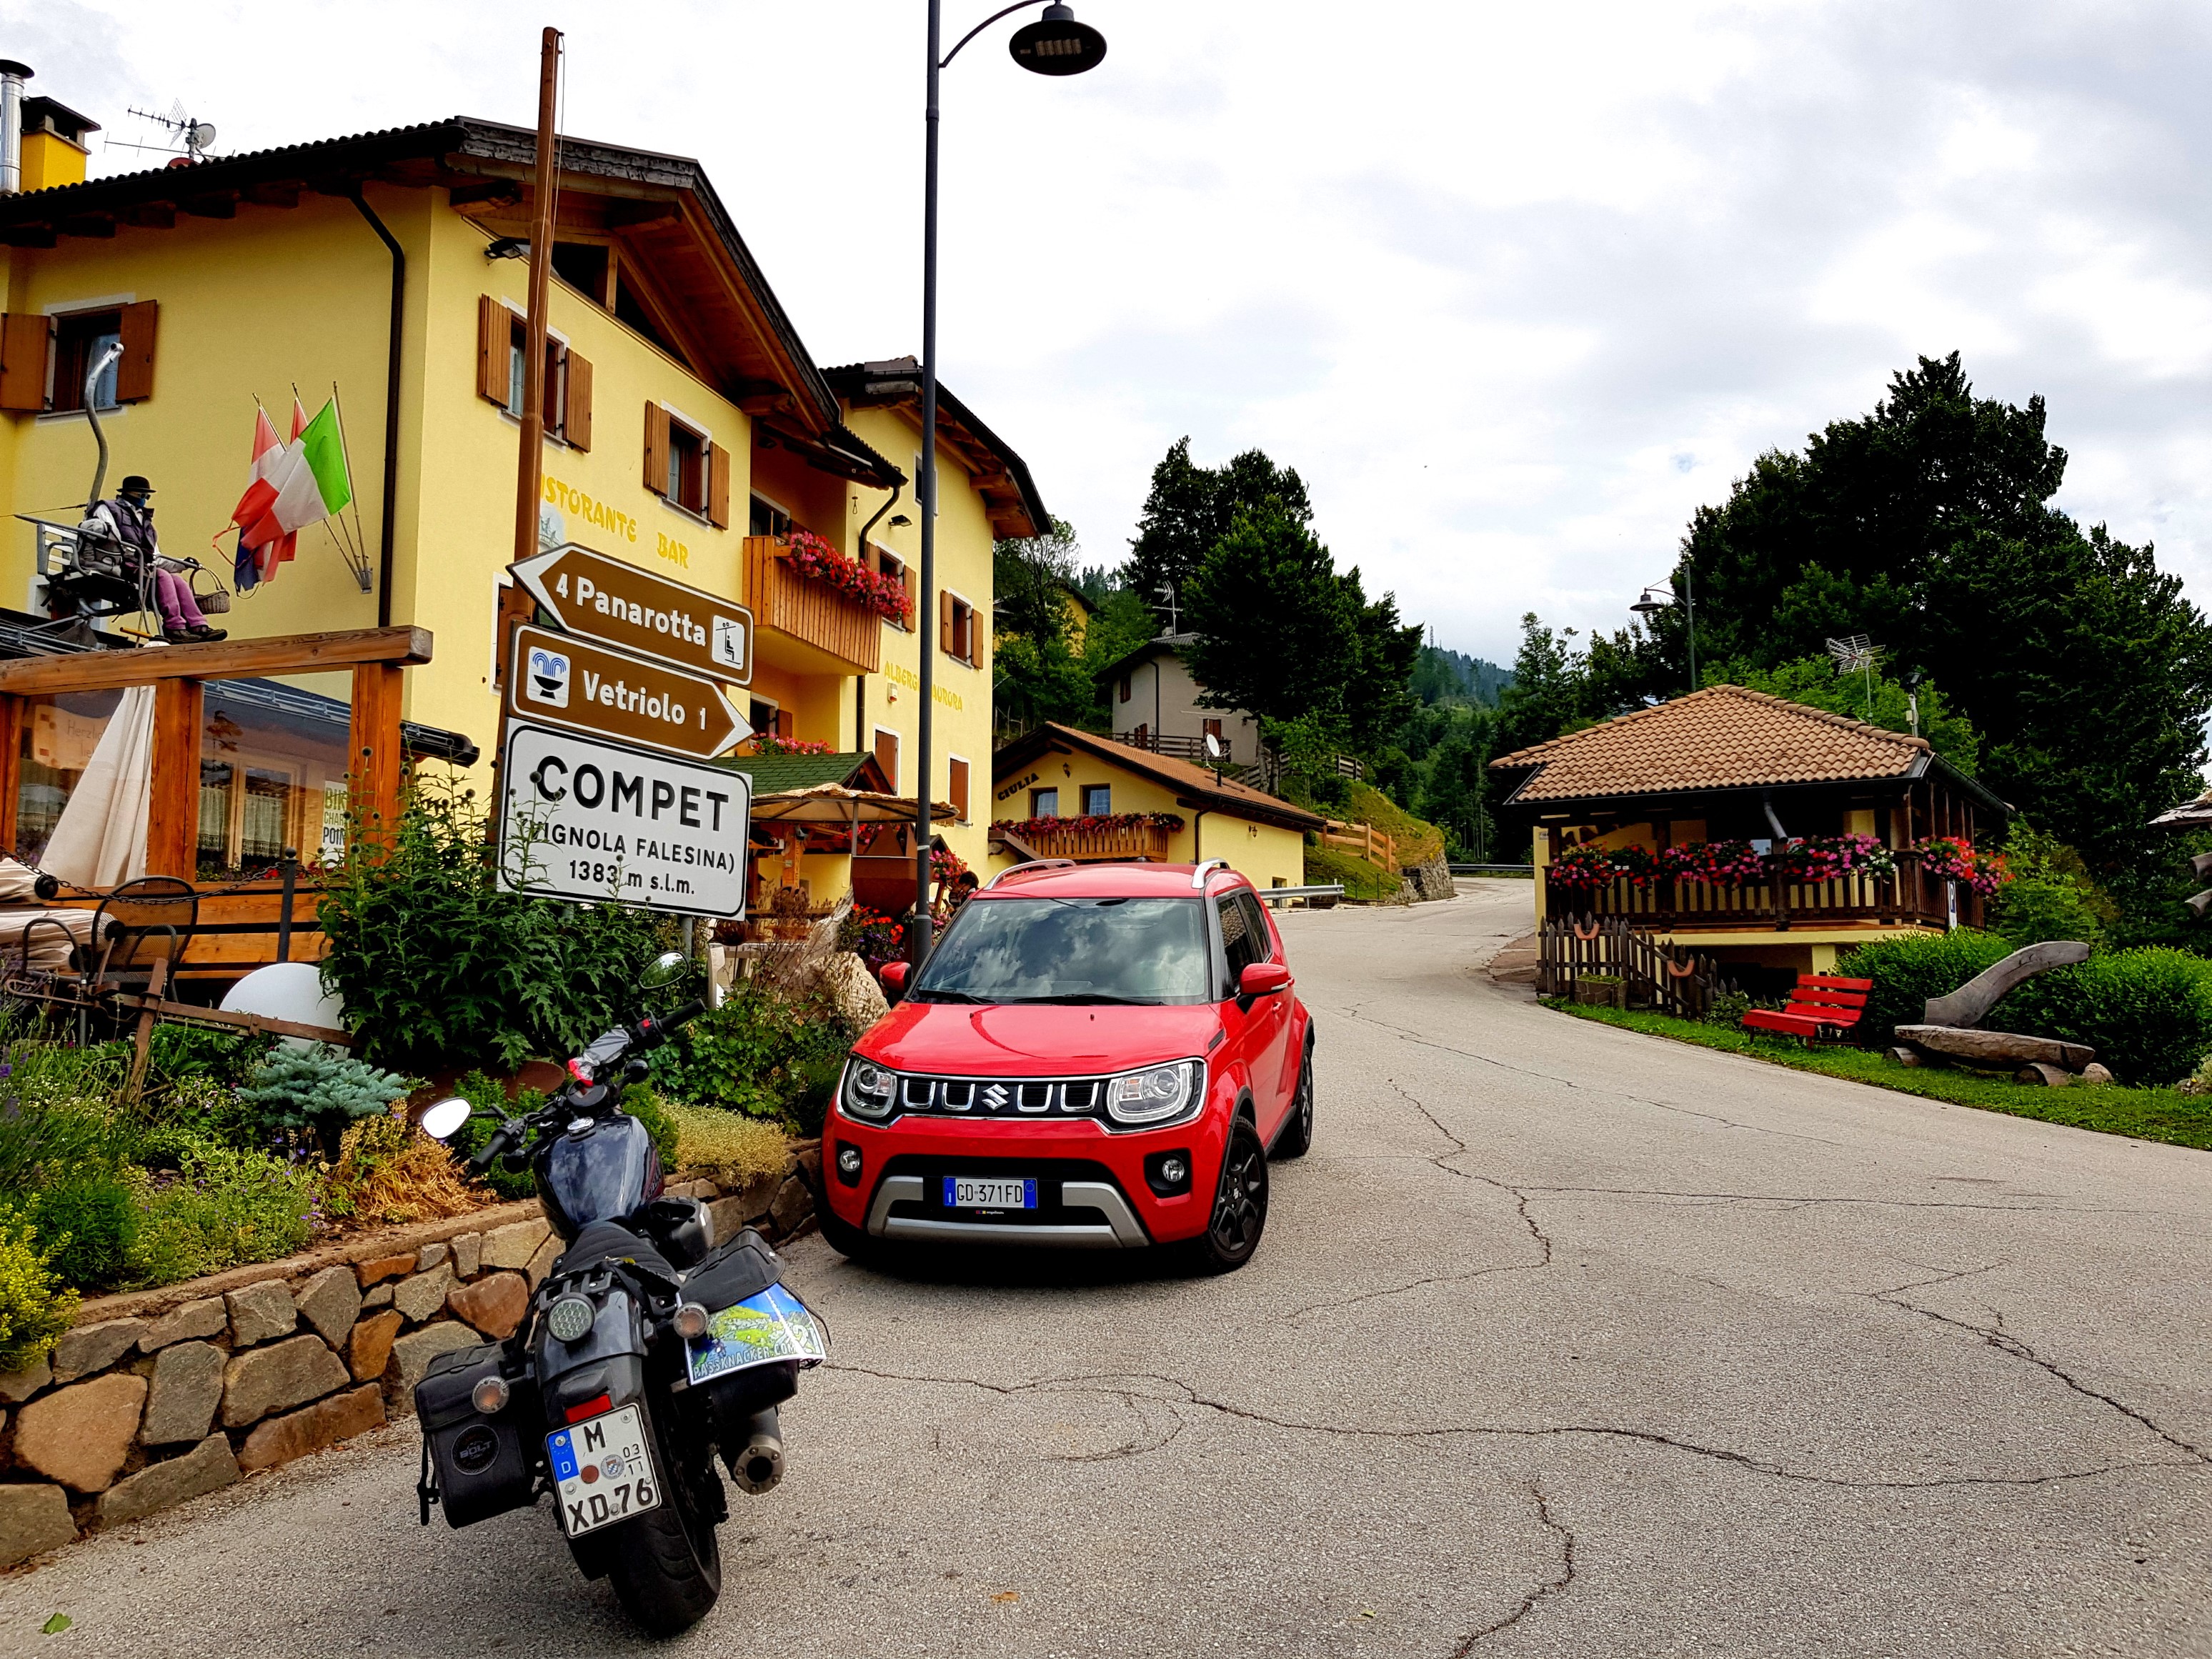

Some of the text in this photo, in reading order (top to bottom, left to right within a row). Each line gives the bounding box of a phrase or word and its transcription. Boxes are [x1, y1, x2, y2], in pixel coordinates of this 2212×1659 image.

[657, 532, 688, 569] BAR
[556, 573, 706, 647] 4 Panarotta
[885, 660, 920, 692] ALBERG
[582, 669, 707, 730] Vetriolo 1
[536, 755, 729, 832] COMPET
[570, 860, 619, 885] 1383
[628, 872, 642, 887] m
[637, 838, 734, 875] FALESINA)
[583, 1421, 607, 1453] M
[622, 1443, 641, 1458] 03
[560, 1461, 572, 1475] D
